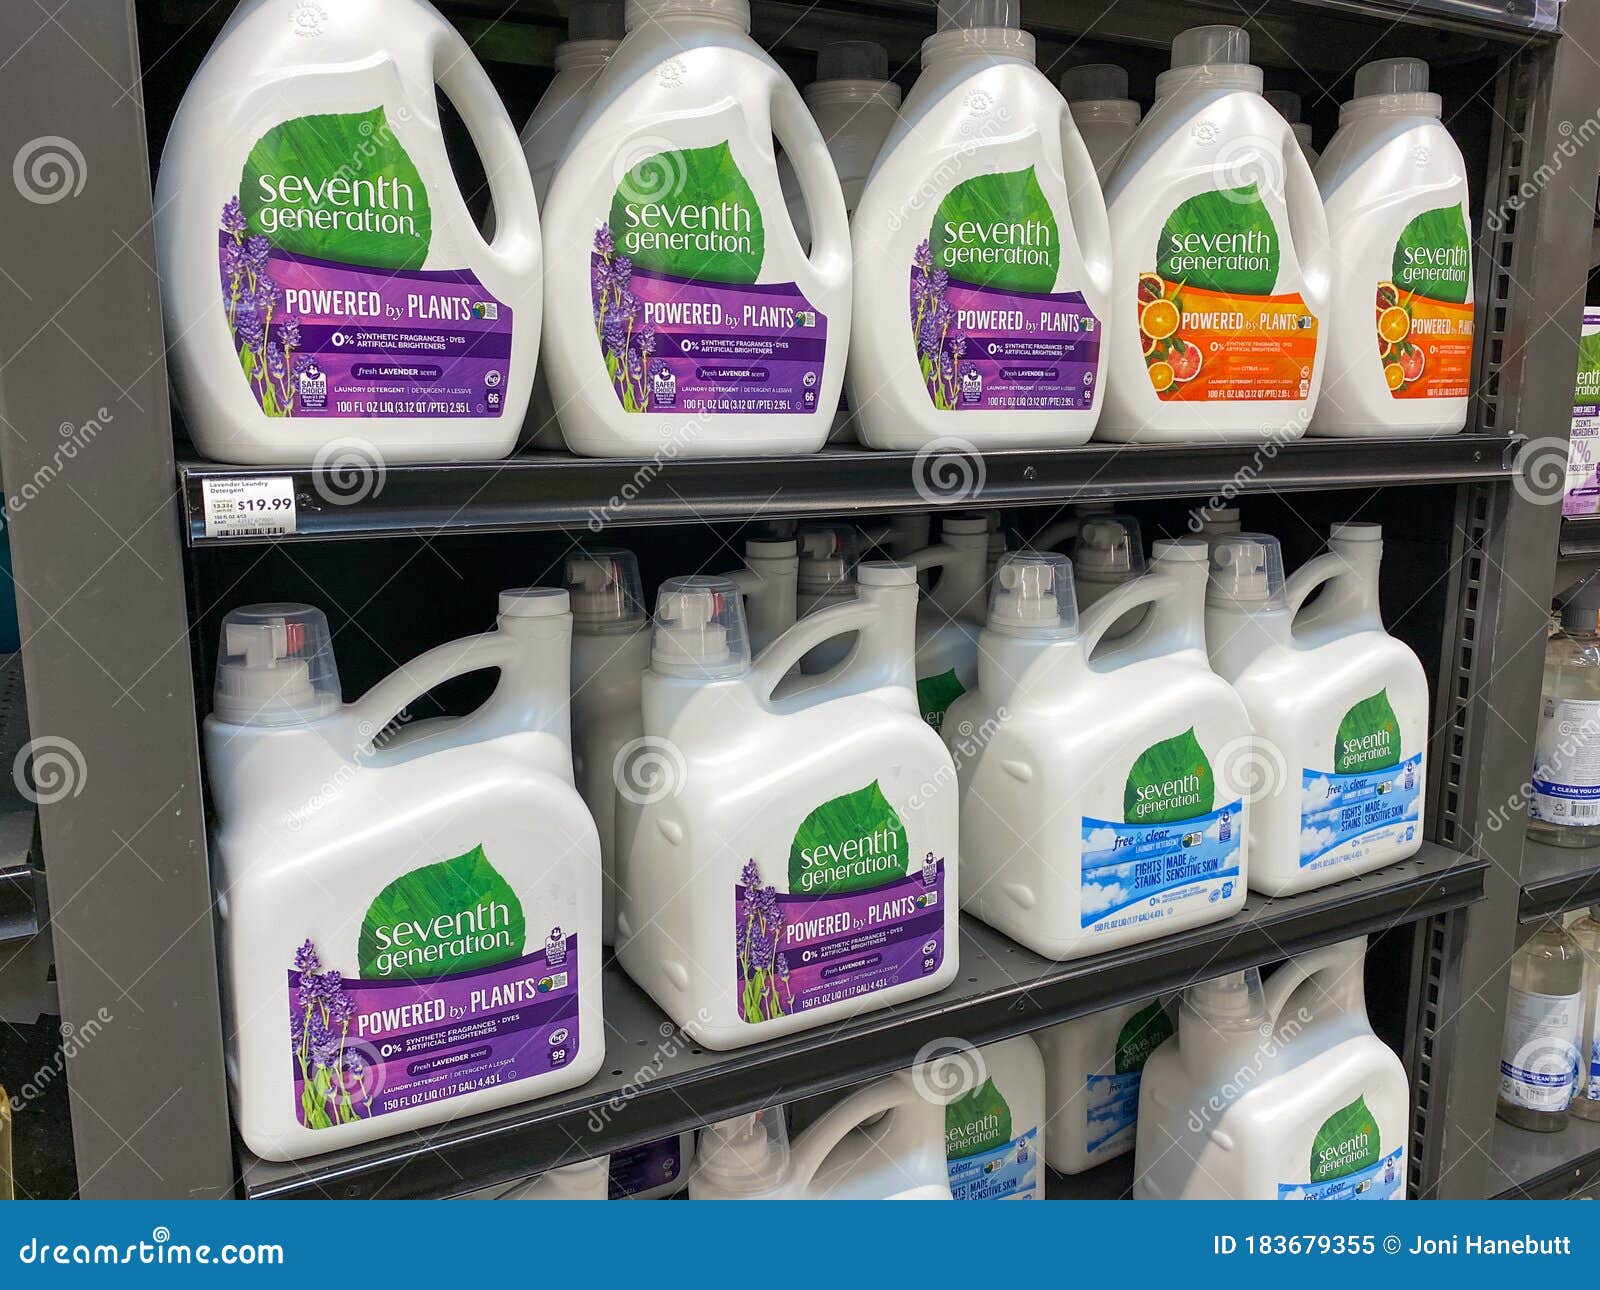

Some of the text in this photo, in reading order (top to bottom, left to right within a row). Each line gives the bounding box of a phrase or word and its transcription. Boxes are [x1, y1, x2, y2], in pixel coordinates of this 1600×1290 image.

[258, 174, 414, 212] seventh
[259, 207, 416, 237] generation
[624, 202, 750, 233] seventh
[624, 232, 751, 255] generation
[944, 220, 1049, 247] seventh
[1171, 231, 1270, 254] seventh
[943, 246, 1050, 267] generation
[1170, 254, 1270, 274] generation
[1404, 245, 1467, 267] seventh
[1403, 267, 1466, 284] generation
[285, 288, 471, 321] POWERED by PLANTS
[644, 302, 794, 329] POWERED by PLANTS
[957, 310, 1079, 333] POWERED by PLANTS
[1181, 312, 1244, 330] POWERED
[1259, 313, 1297, 330] PLANTS
[1411, 318, 1451, 335] POWERED
[331, 332, 355, 347] 0%
[356, 333, 399, 341] SYNTHETIC
[400, 334, 445, 343] FRAGRANCES
[356, 341, 446, 350] ARTIFICIAL BRIGHTENERS
[680, 339, 773, 352] 0% SYNTHETIC FRAGRANCES
[734, 347, 773, 355] BRIGHTENERS
[357, 367, 378, 376] fresh
[379, 368, 419, 376] LAVENDER
[367, 386, 405, 394] DETERGENT
[488, 393, 500, 404] 66
[805, 392, 814, 401] 66
[336, 402, 471, 413] 100 FL OZ LIQ (3.12 QT /PTE) 2.95 L
[683, 400, 786, 410] 100 FL OZ LIQ (3.12 QT 2.95
[238, 498, 292, 511] $19.99
[1343, 729, 1390, 756] seventh
[1343, 747, 1391, 769] generation
[1136, 773, 1199, 802] seventh
[1326, 784, 1342, 799] free
[1349, 778, 1368, 790] clear
[1557, 786, 1578, 794] CLEAN
[1136, 792, 1200, 818] generation
[1341, 800, 1381, 820] FIGHTS MADE
[1341, 804, 1404, 832] STAINS SENSITIVE SKIN
[800, 828, 897, 869] seventh
[1112, 835, 1134, 851] free
[1145, 829, 1170, 841] clear
[801, 853, 898, 892] generation
[1134, 858, 1218, 889] STAINS SENSITIVE SKIN
[1135, 859, 1162, 877] FIGHTS
[1166, 854, 1187, 869] MADE
[375, 900, 510, 951] seventh
[786, 895, 915, 945] POWERED by PLANTS
[376, 929, 511, 976] generation
[802, 950, 818, 962] 0%
[820, 936, 887, 958] ARTIFICIAL BRIGHTENERS
[838, 959, 866, 971] LAVENDER
[924, 958, 934, 968] 99
[357, 978, 536, 1037] POWERED by PLANTS
[802, 998, 813, 1009] 150
[813, 996, 821, 1005] FL
[822, 994, 830, 1003] OZ
[380, 1013, 520, 1058] 0% SYNTHETIC FRAGRANCES DYES
[405, 1026, 498, 1052] ARTIFICIAL BRIGHTENERS
[412, 1049, 488, 1074] fresh LAVENDER scent
[552, 1049, 565, 1060] 99
[383, 1057, 516, 1094] LAUNDRY DETERGENT LESSIVE
[383, 1073, 502, 1112] 150 FL OZ LIQ (1.17 GAL) L
[1319, 1132, 1368, 1163] seventh
[951, 1161, 973, 1174] clear
[1319, 1147, 1369, 1176] generation
[970, 1178, 988, 1192] MADE
[1002, 1177, 1017, 1192] SKIN
[1326, 1181, 1346, 1196] clear
